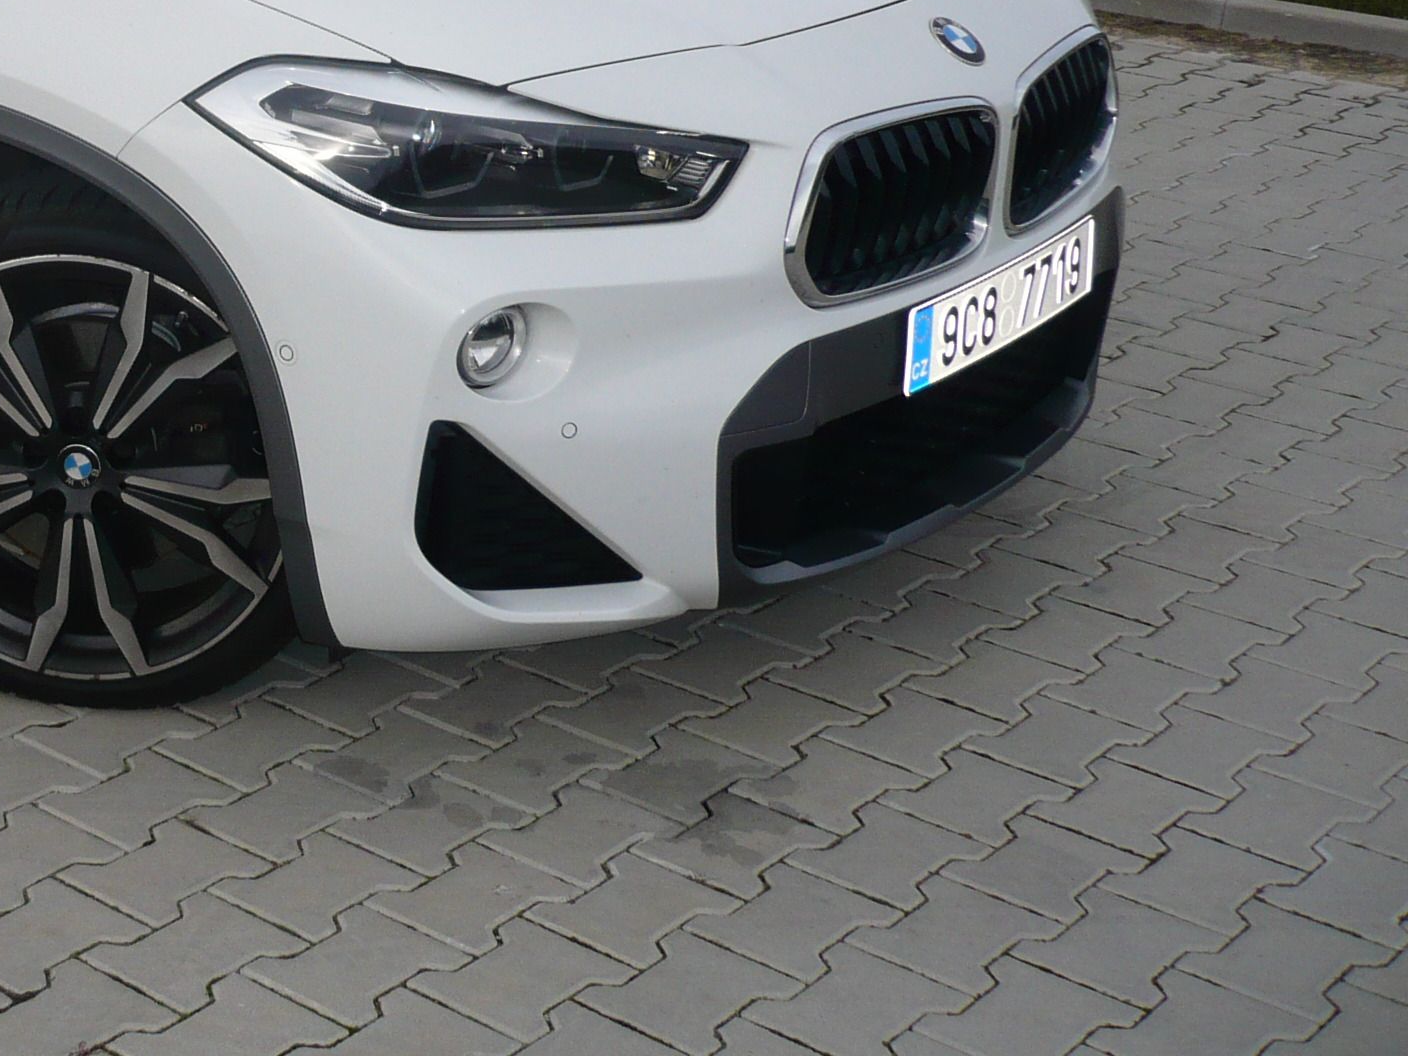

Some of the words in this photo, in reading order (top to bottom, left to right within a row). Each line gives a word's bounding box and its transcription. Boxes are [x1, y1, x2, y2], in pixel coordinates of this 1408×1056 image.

[939, 285, 998, 366] 9C8
[1016, 236, 1081, 328] 7719
[911, 358, 929, 381] CZ
